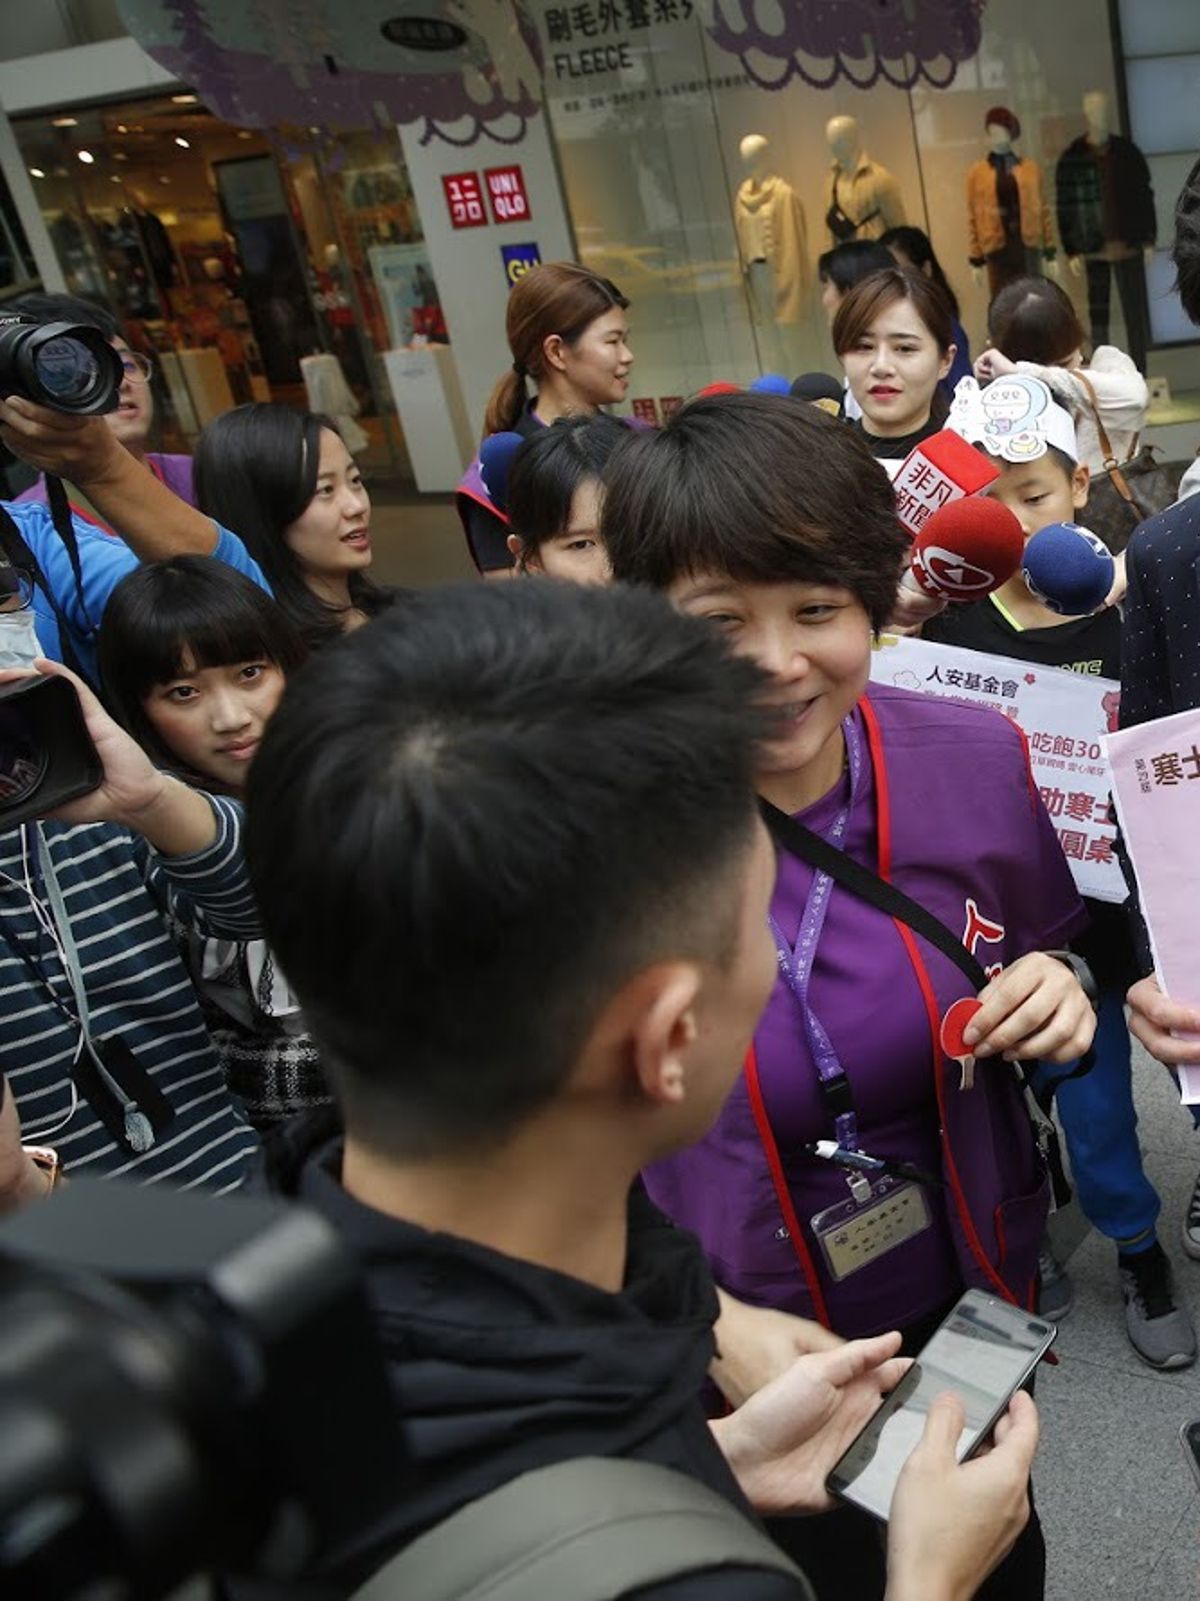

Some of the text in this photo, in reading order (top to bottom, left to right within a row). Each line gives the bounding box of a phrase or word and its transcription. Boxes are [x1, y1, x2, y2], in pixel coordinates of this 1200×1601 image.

[554, 43, 633, 79] FLEECE
[489, 172, 519, 195] UNI
[495, 194, 526, 219] QLO
[907, 462, 953, 508] 非凡
[925, 664, 1020, 699] 人安基金會
[1027, 731, 1101, 760] 吃飽30
[1055, 828, 1114, 864] 圓桌
